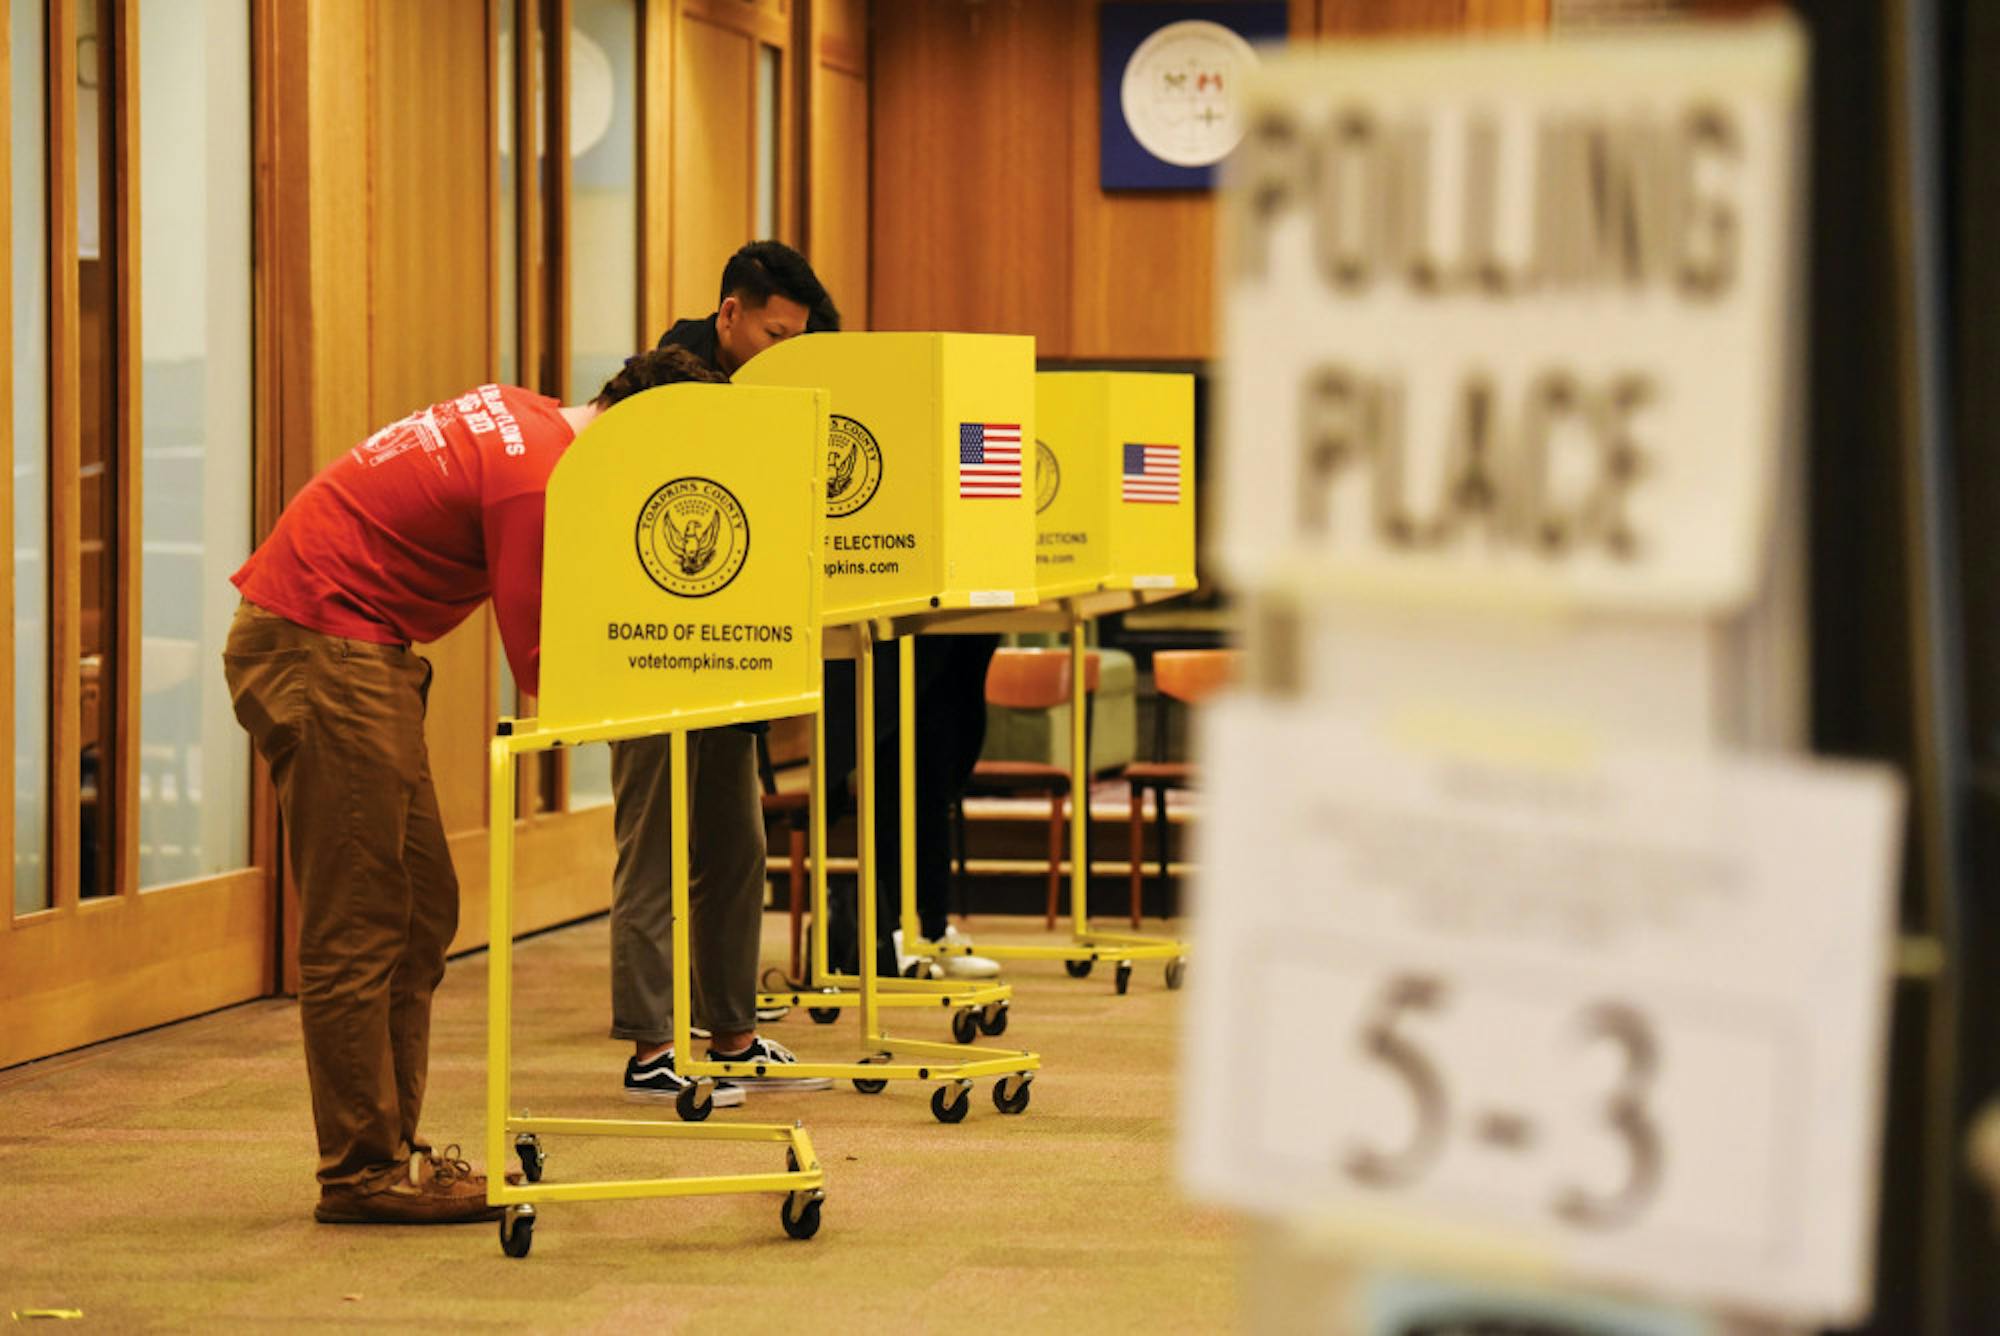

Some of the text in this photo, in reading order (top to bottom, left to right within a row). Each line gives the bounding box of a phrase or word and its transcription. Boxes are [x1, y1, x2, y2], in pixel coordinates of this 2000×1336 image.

[1243, 104, 1739, 299] POLLING
[1295, 366, 1658, 558] PLACE
[641, 482, 744, 530] TOMPKINS COUNTY
[834, 533, 915, 550] ELECTIONS
[1036, 533, 1087, 545] ECTIONS
[607, 623, 793, 642] BOARD OF ELECTIONS
[628, 653, 773, 673] votetompkins.com
